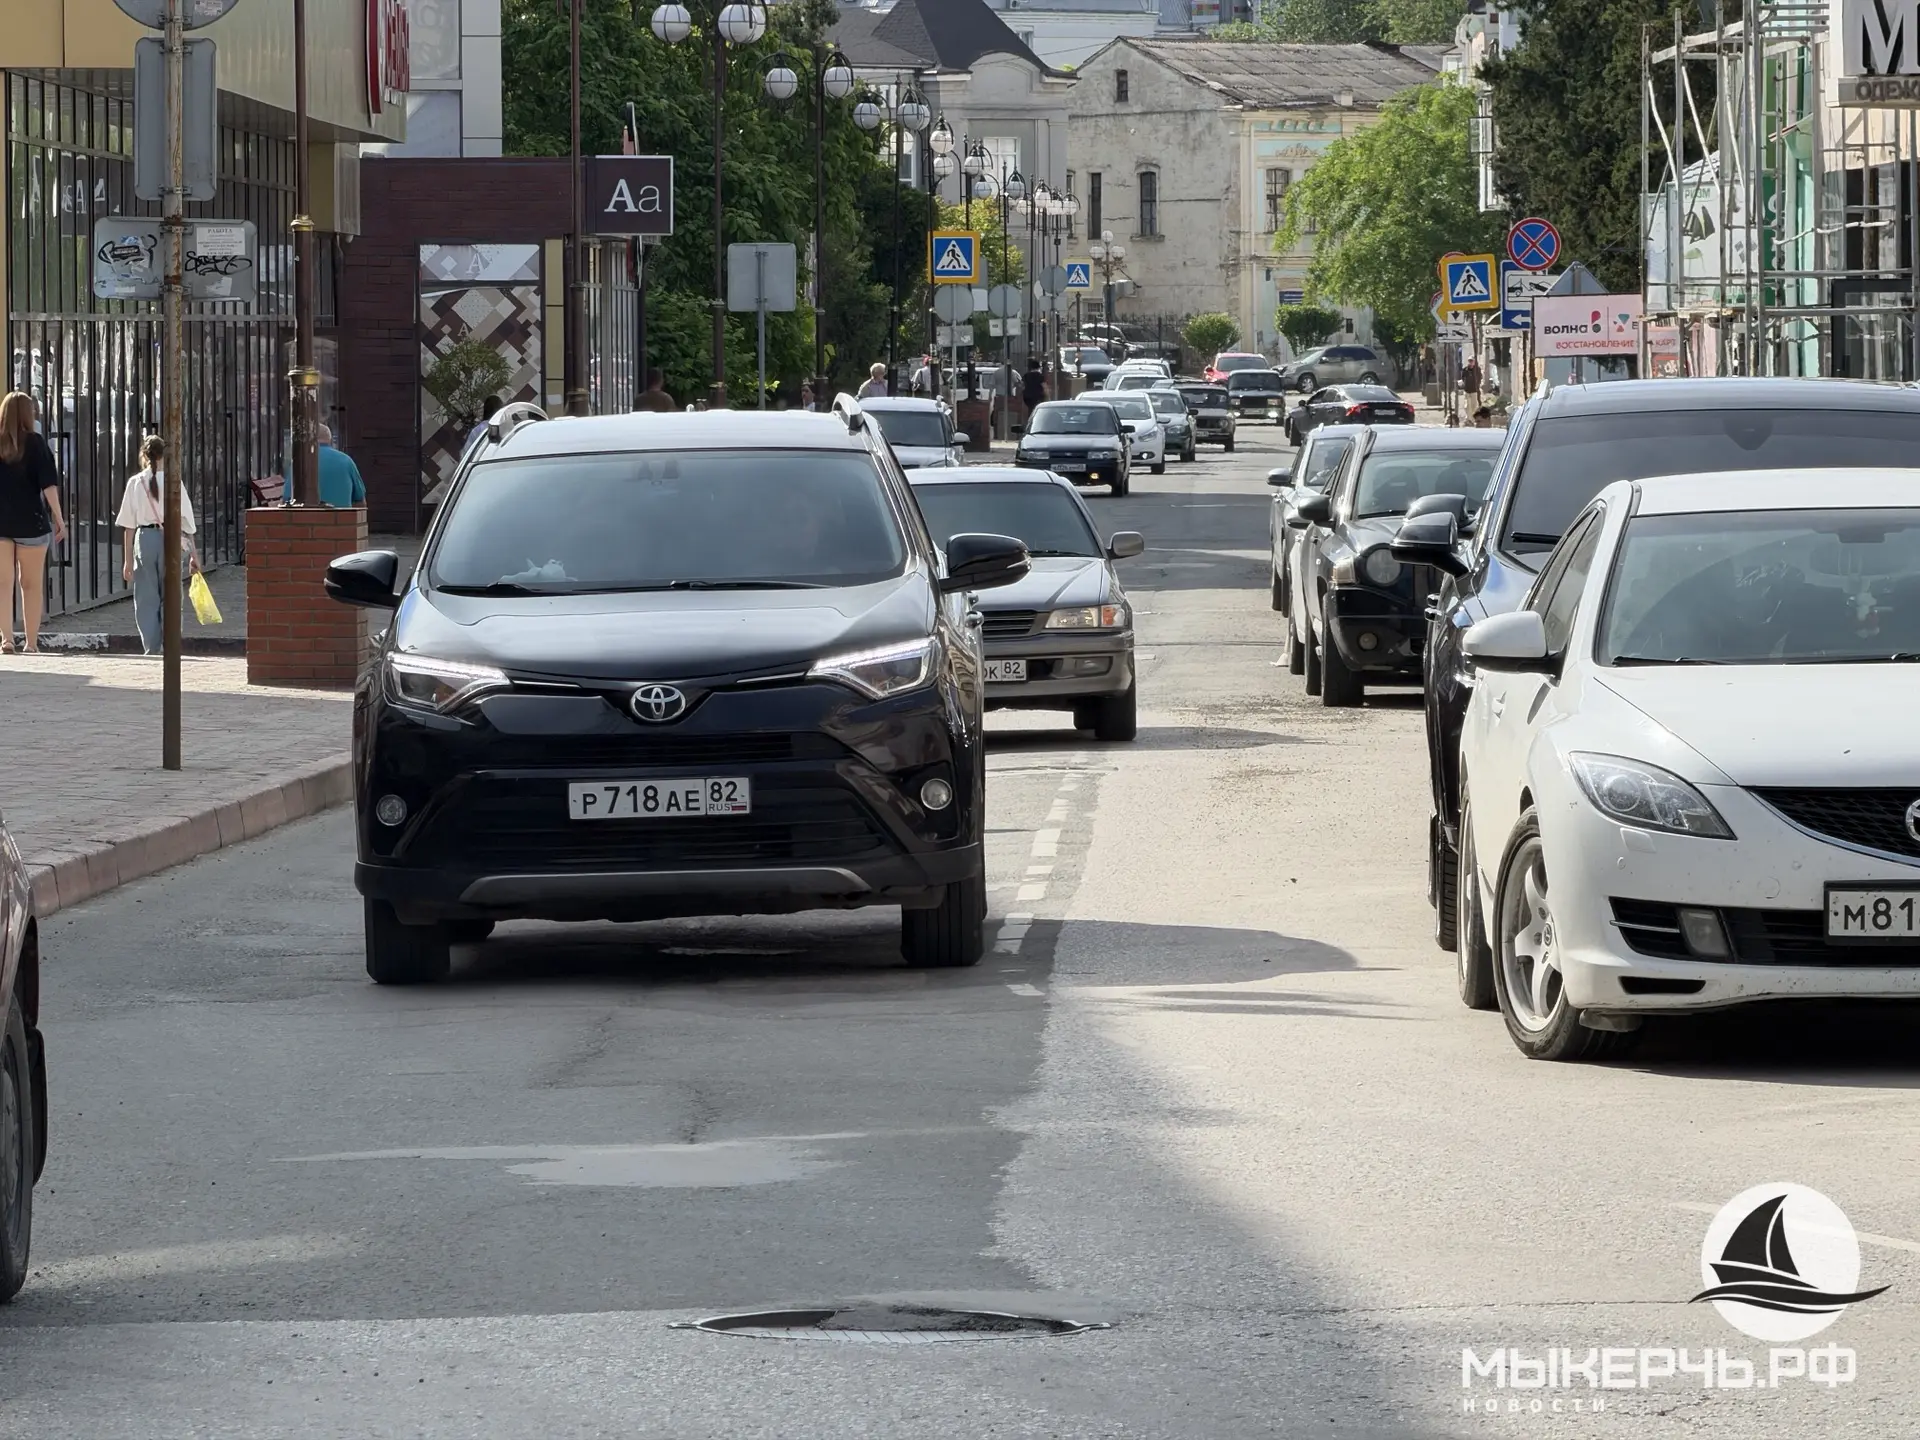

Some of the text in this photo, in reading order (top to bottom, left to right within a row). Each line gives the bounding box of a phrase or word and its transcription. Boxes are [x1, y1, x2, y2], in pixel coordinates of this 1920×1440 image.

[1855, 80, 1920, 101] ОДЕЖ
[603, 178, 662, 213] Aa
[1555, 340, 1635, 350] ВОССТАНОВЛЕНИЕ
[1004, 661, 1021, 674] 82
[582, 780, 738, 815] Р718АЕ 82
[708, 803, 731, 812] RUS
[1843, 897, 1920, 931] М81
